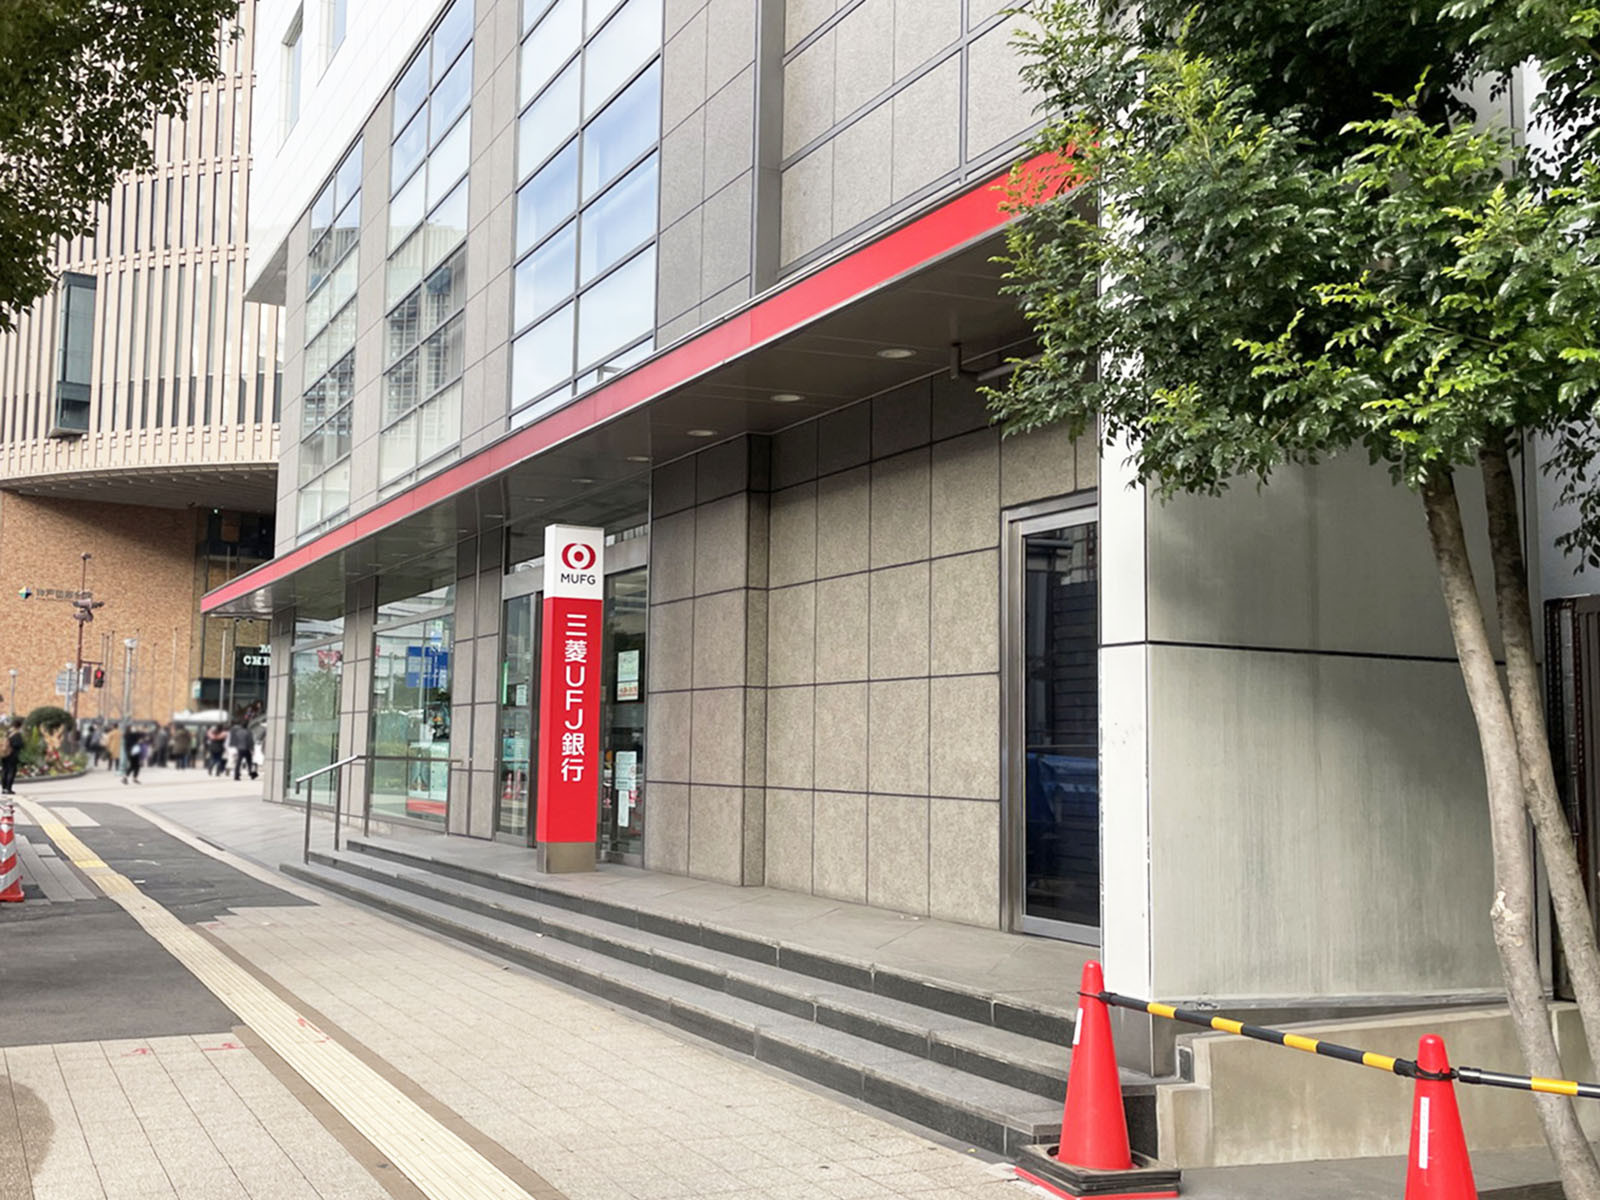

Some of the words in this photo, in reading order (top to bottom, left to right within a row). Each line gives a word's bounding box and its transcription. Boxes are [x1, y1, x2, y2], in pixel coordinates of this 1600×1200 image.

[560, 573, 596, 585] MUFG
[561, 613, 588, 782] 三菱UFJ銀行
